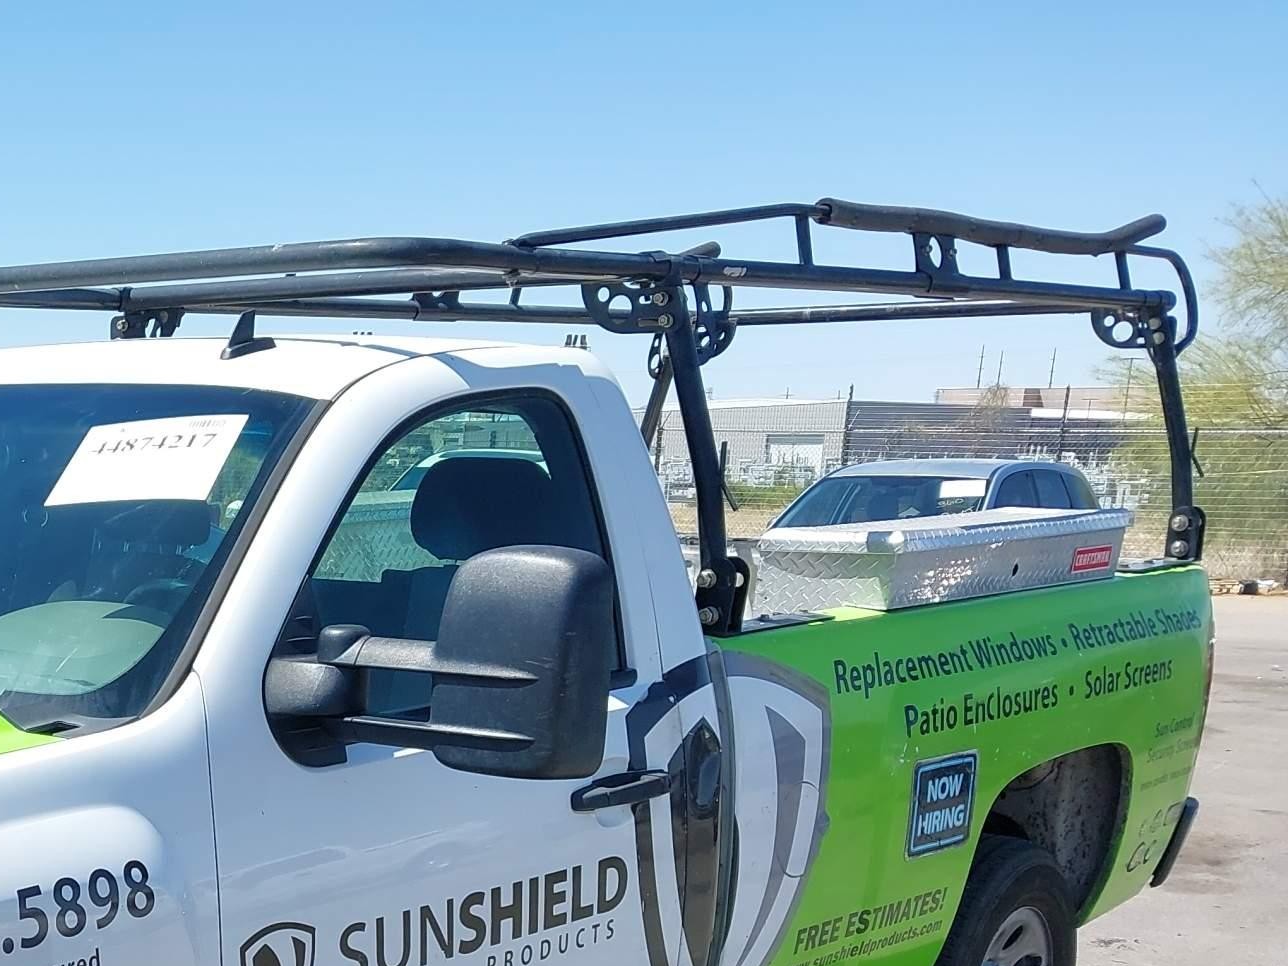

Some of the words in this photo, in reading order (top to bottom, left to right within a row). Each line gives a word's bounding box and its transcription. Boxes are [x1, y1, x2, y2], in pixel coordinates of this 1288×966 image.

[90, 432, 218, 455] 44874217
[833, 644, 973, 699] Replacement
[968, 631, 1057, 670] Windows
[1068, 610, 1157, 651] Retractable
[1155, 608, 1202, 634] Shades
[904, 697, 958, 738] Patio
[1084, 666, 1121, 699] Solar
[1124, 659, 1172, 690] Screens
[927, 773, 964, 803] NOW
[917, 804, 965, 837] HIRING
[793, 916, 844, 955] FREE
[844, 886, 949, 938] ESTIMATES!
